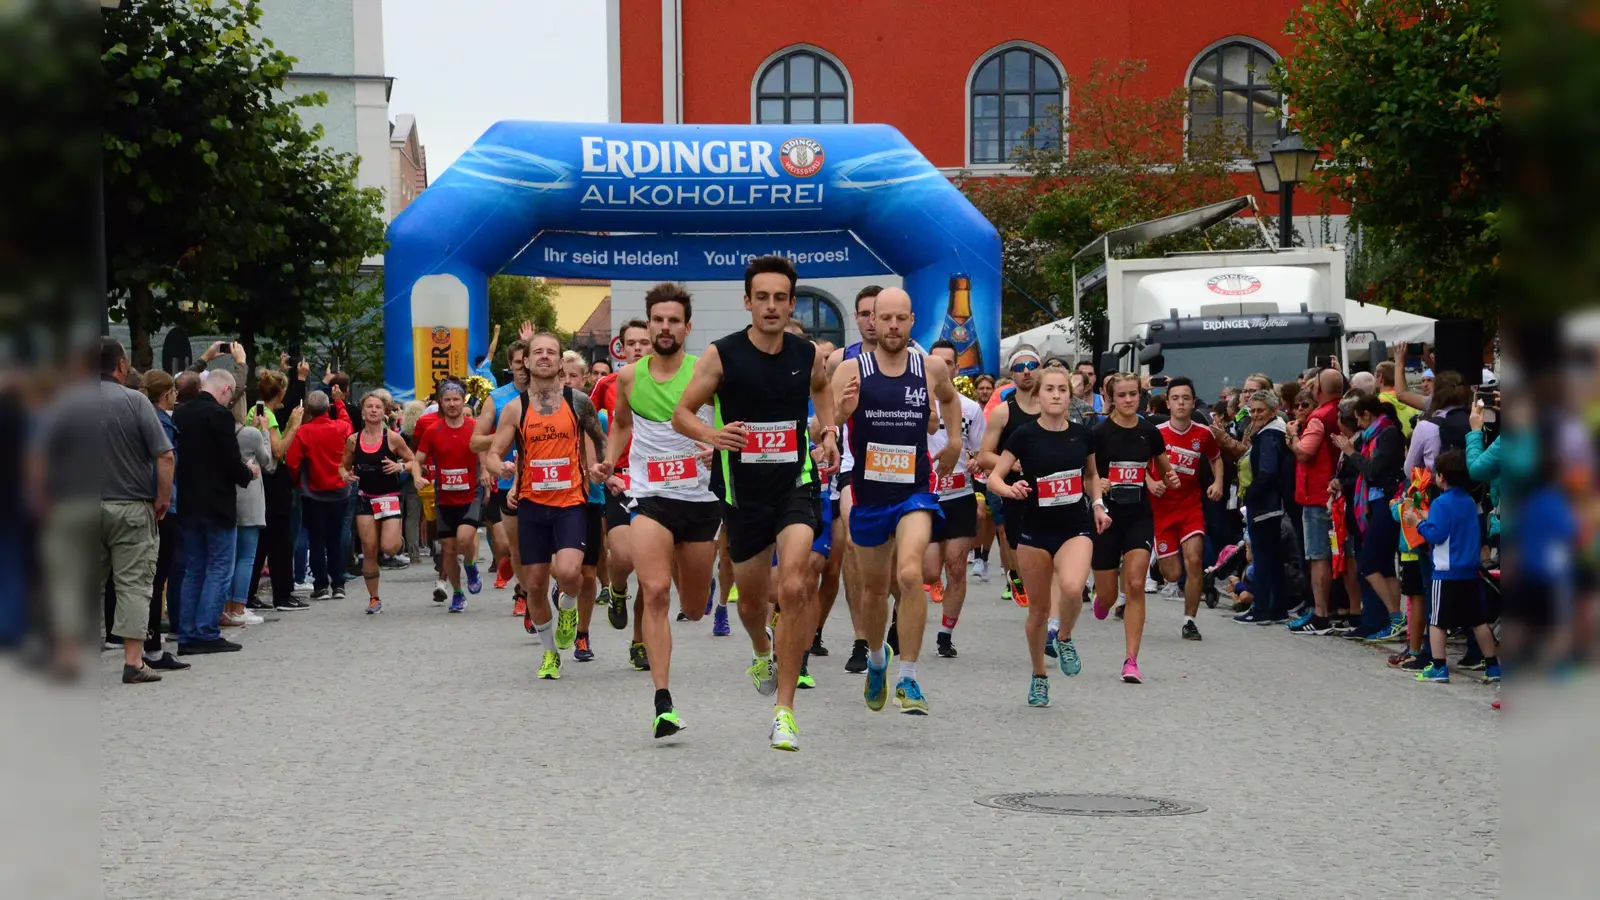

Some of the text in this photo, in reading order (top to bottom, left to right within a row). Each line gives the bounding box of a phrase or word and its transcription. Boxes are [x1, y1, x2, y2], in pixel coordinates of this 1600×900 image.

[781, 139, 822, 154] ERDINGER
[580, 136, 780, 178] ERDINGER
[580, 183, 824, 206] ALKOHOLFREI
[544, 247, 679, 266] Ihr seid Helden!
[787, 247, 850, 264] heroes!
[1202, 320, 1250, 331] ERDINGER
[865, 409, 923, 420] Weihenstephan
[755, 432, 786, 448] 122
[872, 453, 910, 469] 3048
[1177, 454, 1193, 466] 175
[542, 466, 559, 479] 16
[657, 460, 685, 477] 123
[1118, 469, 1138, 480] 102
[445, 475, 463, 484] 274
[940, 477, 954, 488] 35
[1049, 480, 1072, 493] 121
[379, 501, 391, 511] 28
